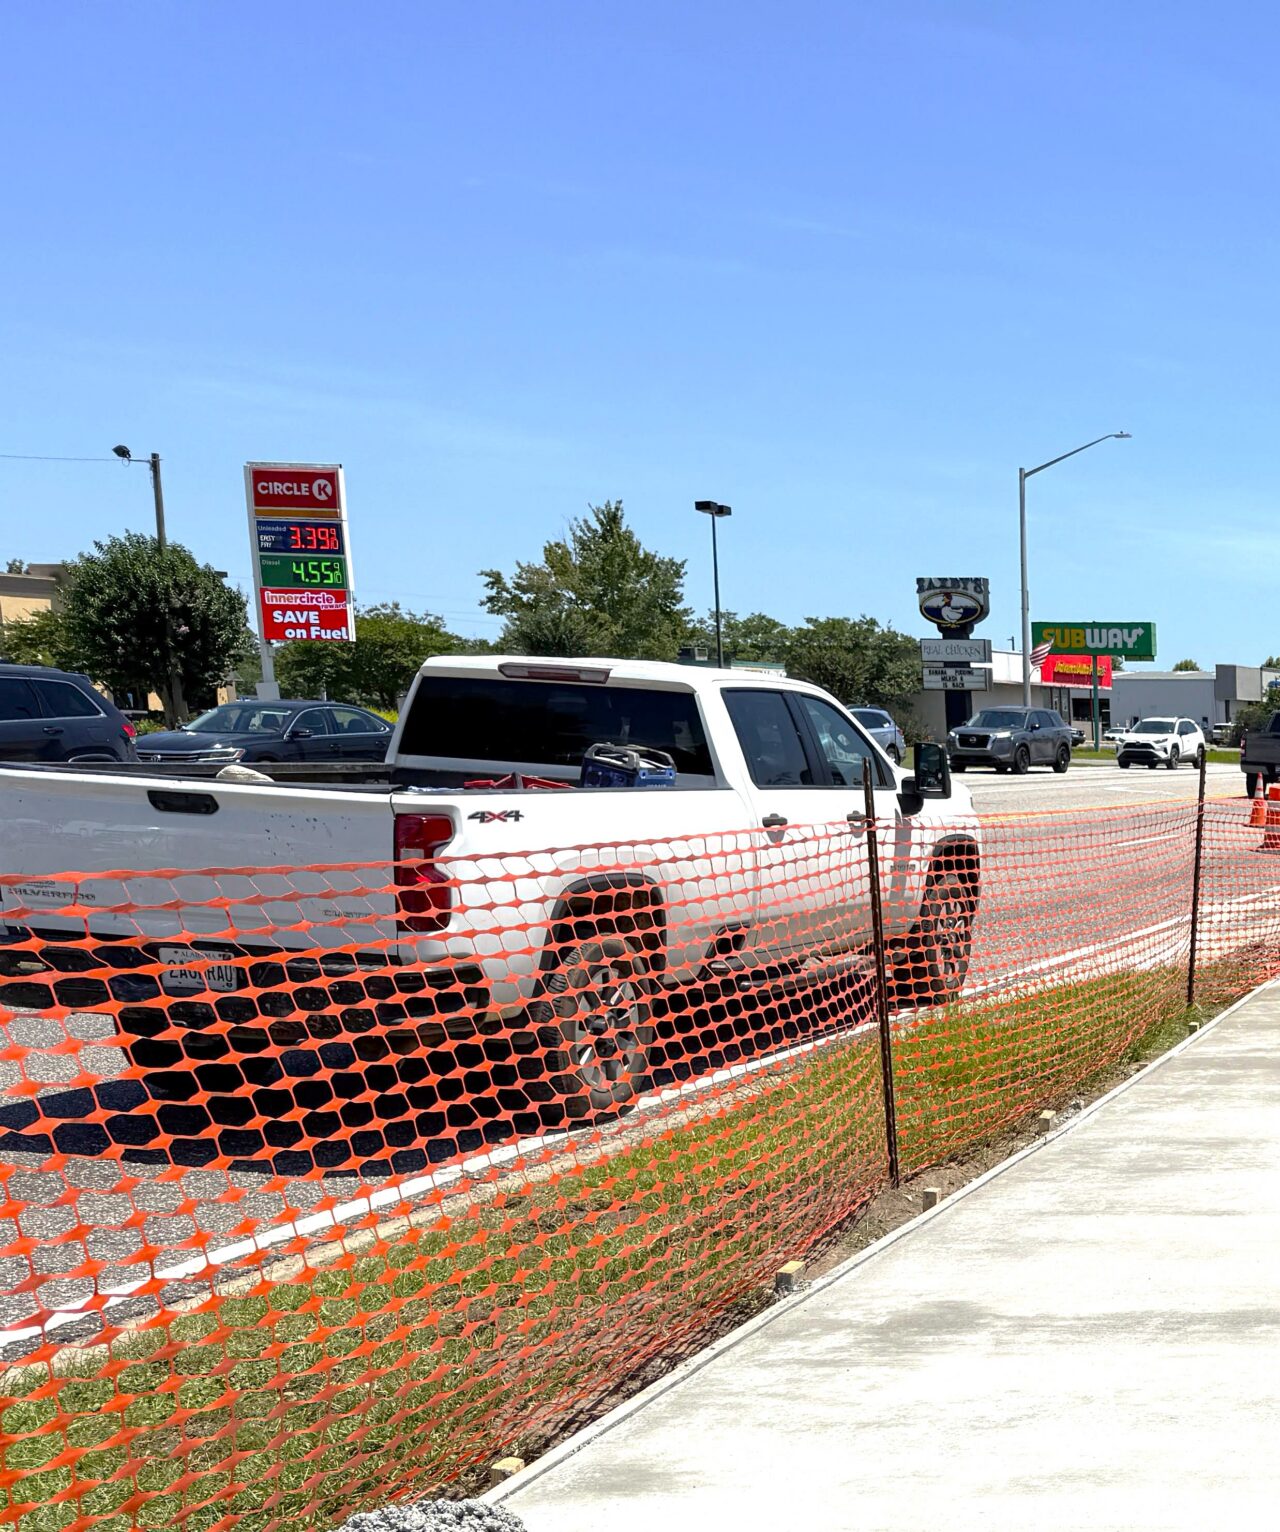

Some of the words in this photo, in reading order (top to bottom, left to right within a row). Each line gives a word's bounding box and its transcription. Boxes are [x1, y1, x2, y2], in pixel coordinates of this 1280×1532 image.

[257, 481, 310, 496] CIRCLE
[314, 480, 332, 499] K
[272, 610, 320, 624] SAVE
[284, 628, 307, 639] on
[310, 626, 348, 640] Fuel
